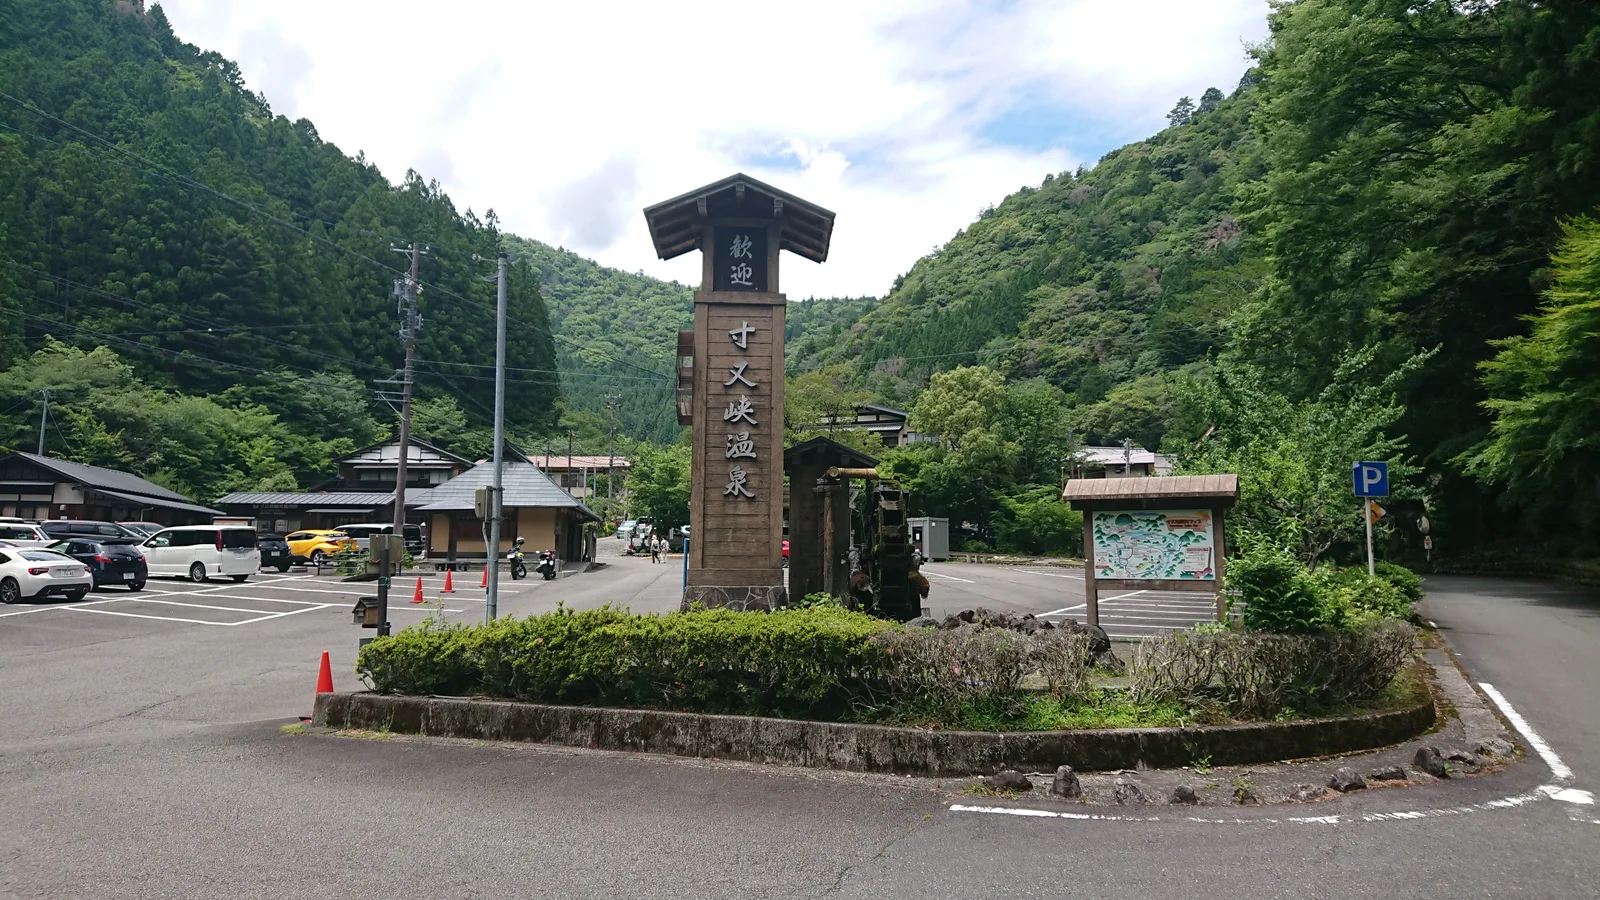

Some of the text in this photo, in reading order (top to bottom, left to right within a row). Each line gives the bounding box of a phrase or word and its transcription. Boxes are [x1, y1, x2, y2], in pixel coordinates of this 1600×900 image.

[729, 234, 753, 286] 歓迎
[723, 320, 758, 499] 寸又峡温泉
[1362, 465, 1382, 493] P
